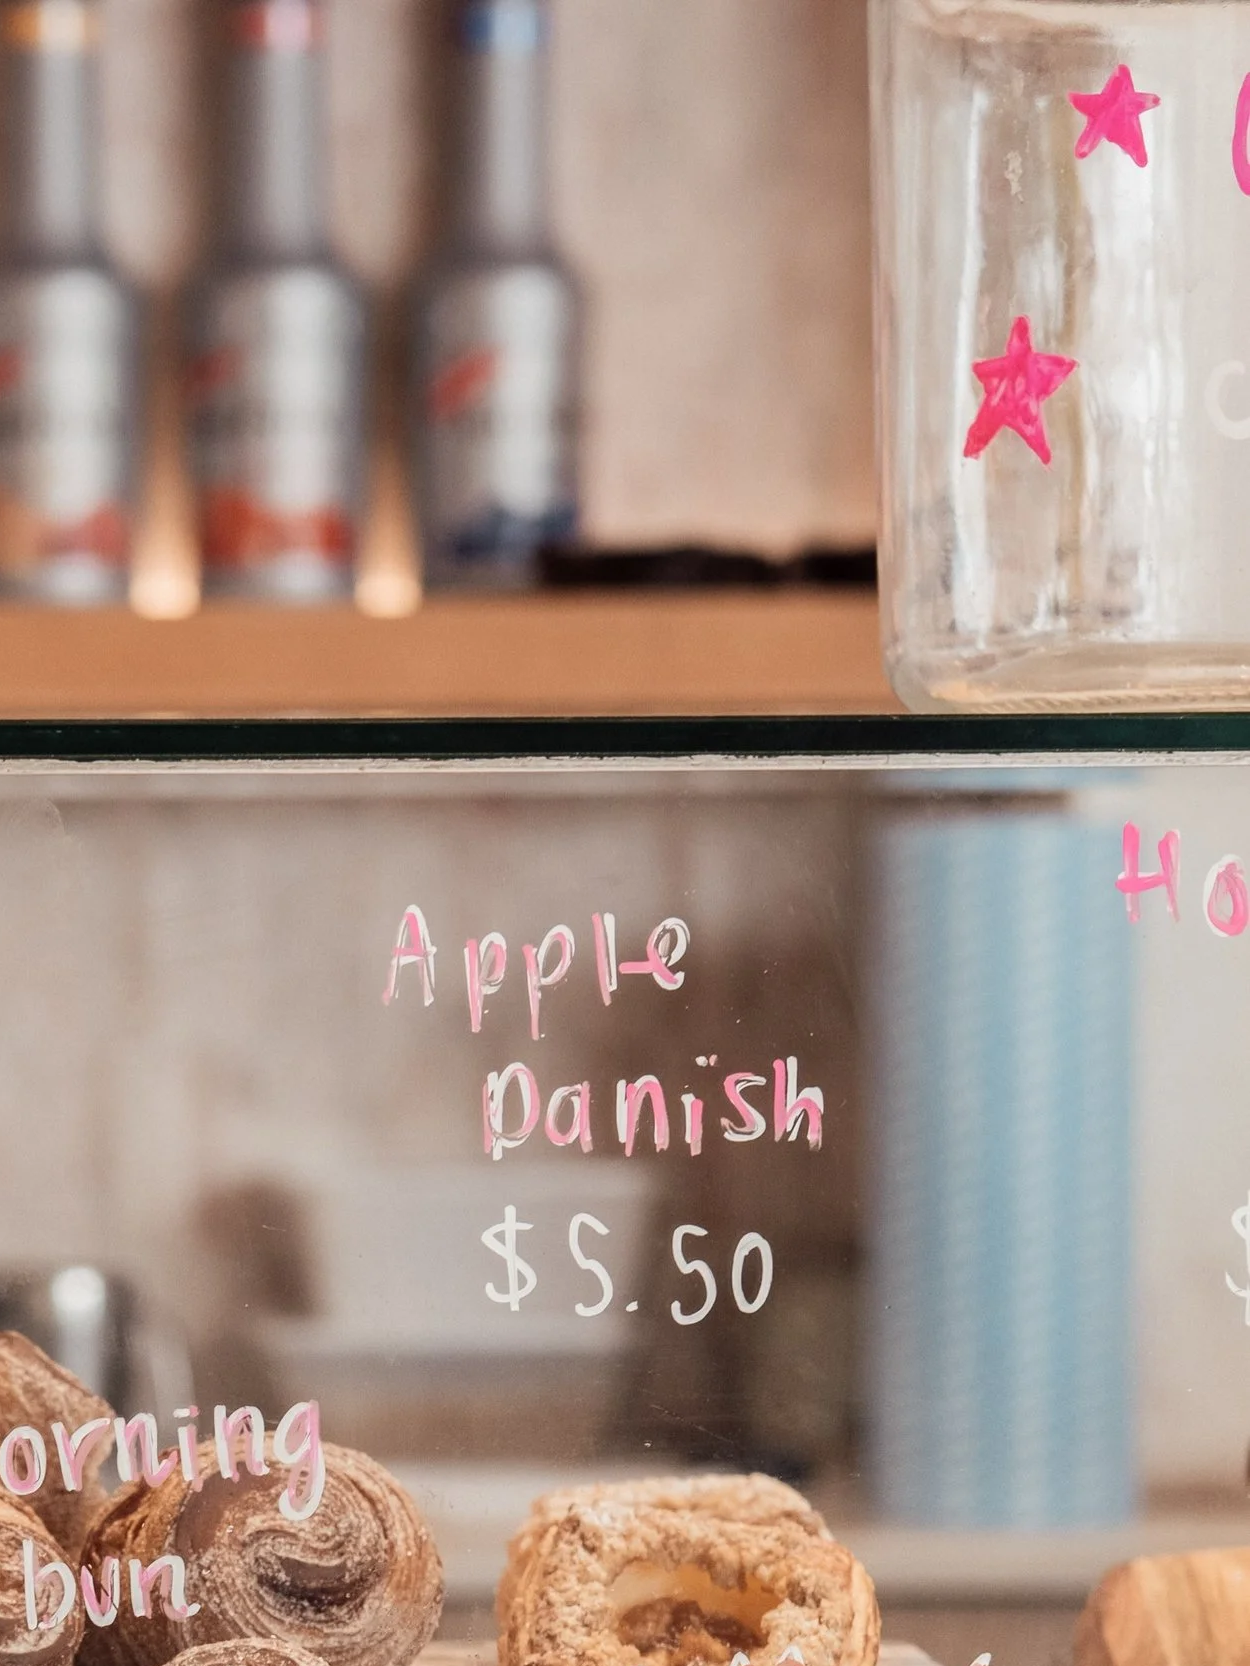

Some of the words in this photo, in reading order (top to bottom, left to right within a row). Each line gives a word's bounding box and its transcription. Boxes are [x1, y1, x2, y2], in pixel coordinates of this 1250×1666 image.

[382, 904, 690, 1040] Apple
[483, 1054, 824, 1160] Danish
[481, 1205, 773, 1326] $5.50
[23, 1539, 201, 1630] bun
